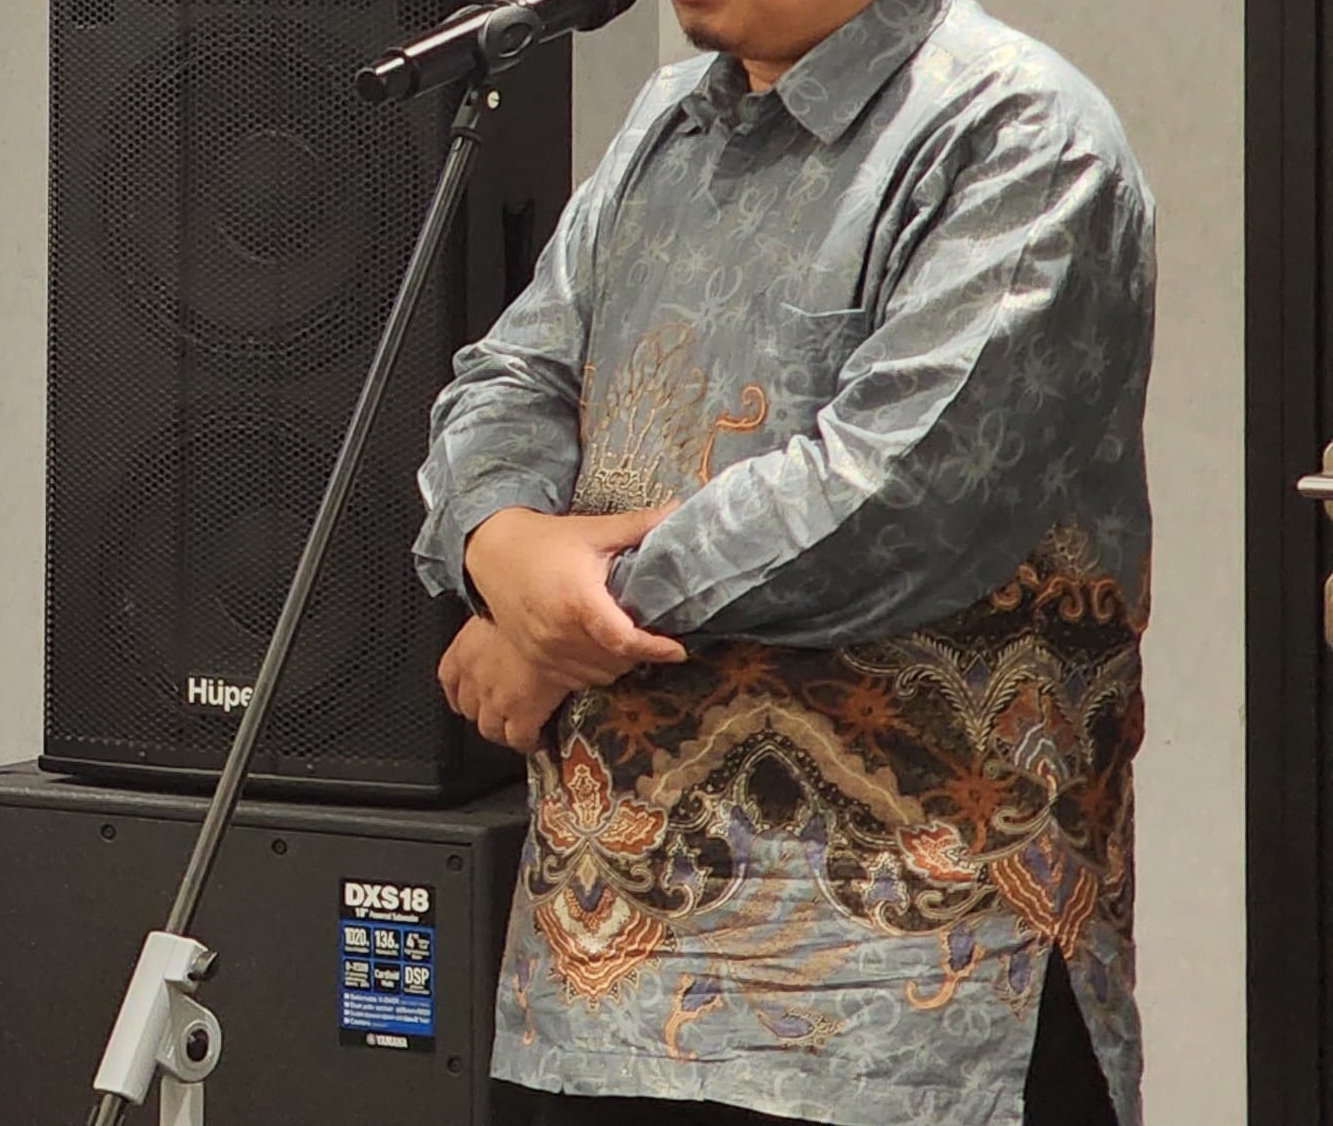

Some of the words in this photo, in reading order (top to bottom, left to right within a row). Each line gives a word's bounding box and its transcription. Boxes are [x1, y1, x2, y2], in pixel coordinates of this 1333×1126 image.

[188, 677, 254, 712] Hüpe
[345, 882, 430, 912] DXS18
[404, 966, 430, 985] DSP
